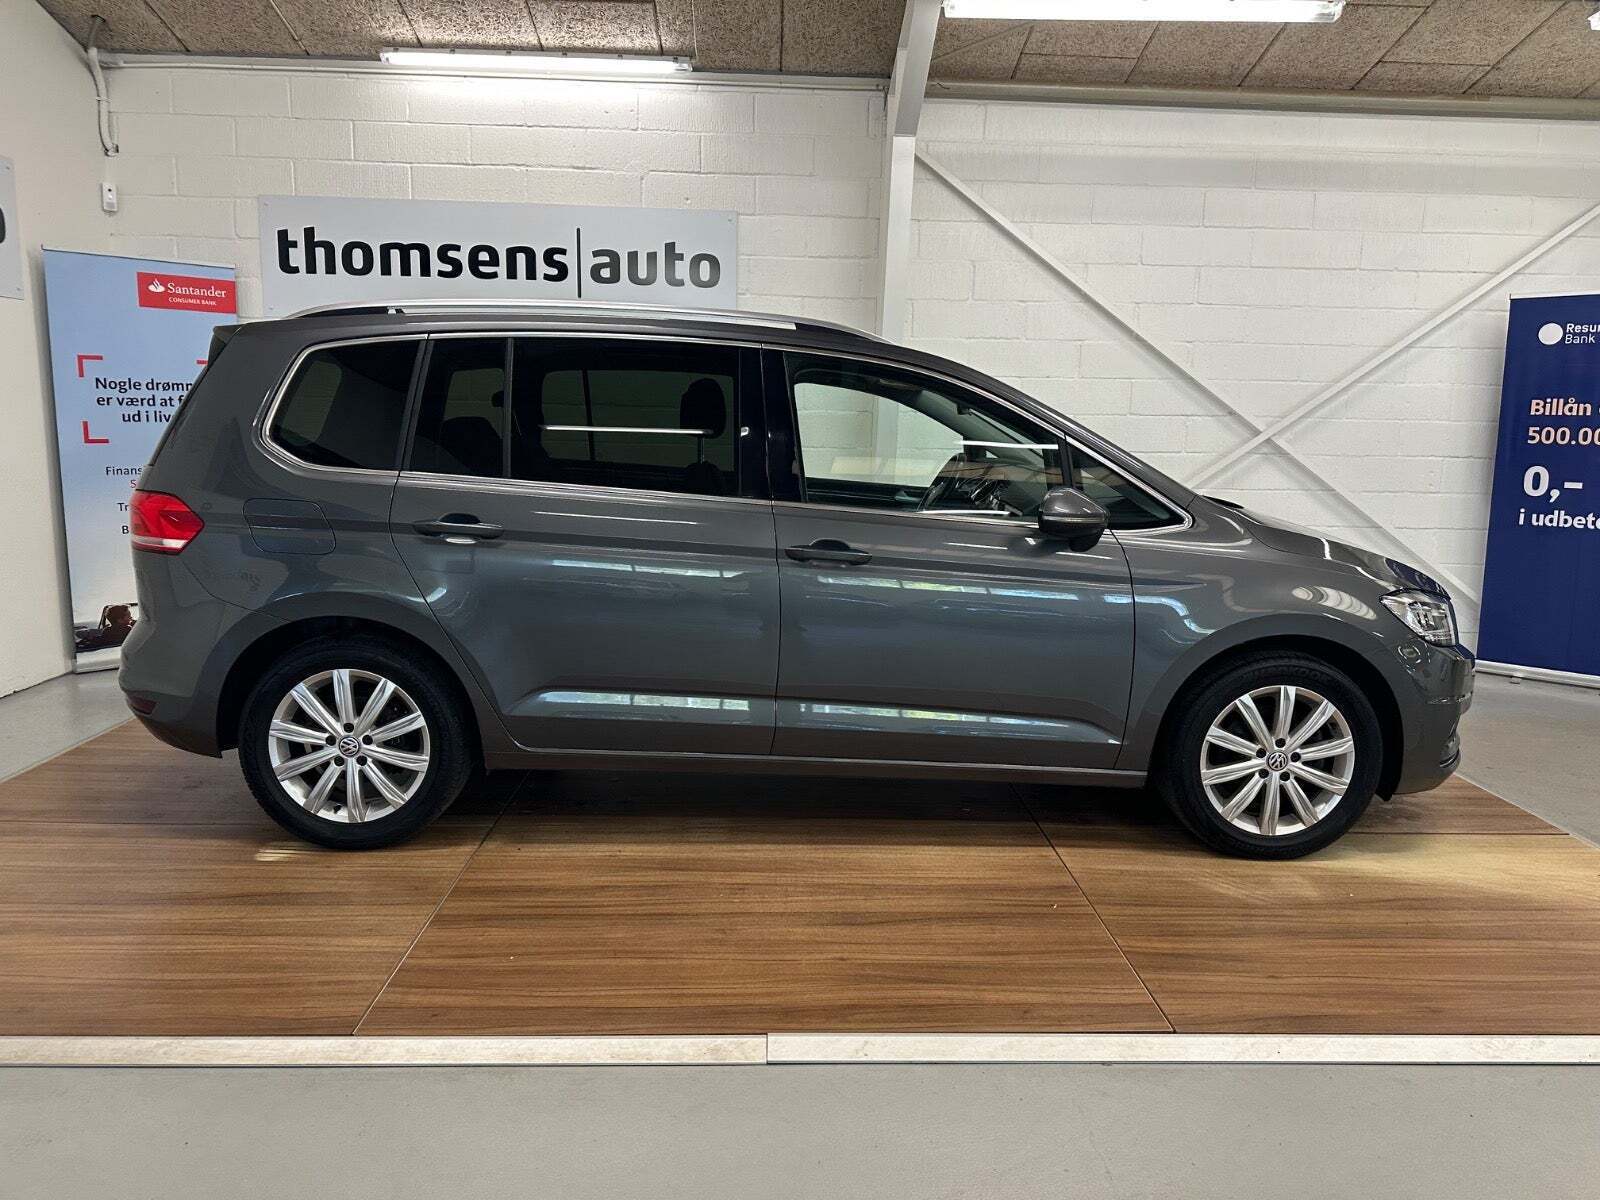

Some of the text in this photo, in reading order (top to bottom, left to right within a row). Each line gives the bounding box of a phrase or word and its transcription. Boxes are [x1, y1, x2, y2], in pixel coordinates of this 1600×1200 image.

[277, 226, 721, 289] thomsens auto
[167, 282, 226, 297] Santander
[168, 297, 201, 305] CONSUMER
[1564, 333, 1596, 344] Bank
[95, 377, 142, 394] Nogle
[96, 396, 113, 406] er
[116, 394, 156, 407] værd
[160, 396, 175, 407] at
[1530, 397, 1592, 416] Billån
[121, 410, 141, 423] ud
[145, 410, 150, 423] i
[1518, 508, 1525, 526] i
